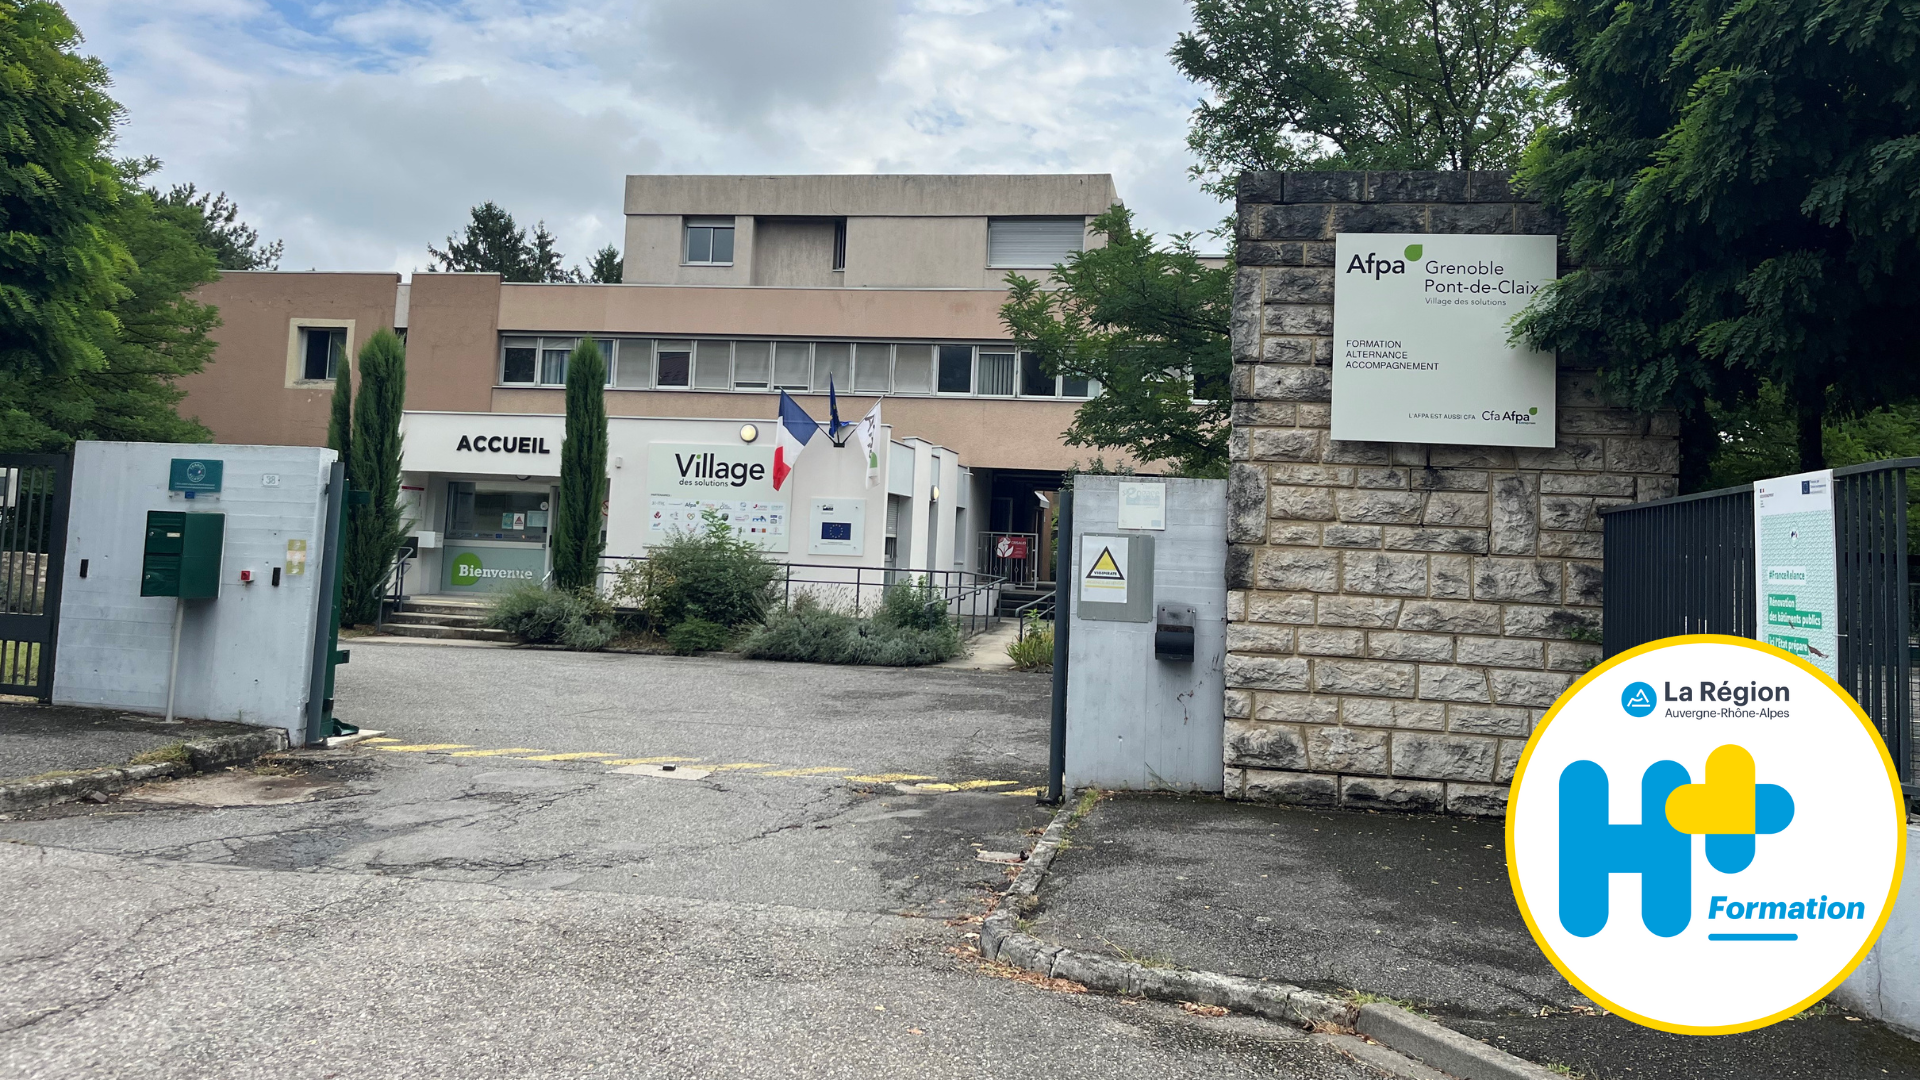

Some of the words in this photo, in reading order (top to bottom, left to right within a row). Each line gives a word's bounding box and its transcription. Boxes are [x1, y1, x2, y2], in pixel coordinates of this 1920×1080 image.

[1346, 253, 1405, 280] Afpa
[1425, 261, 1504, 275] Grenoble
[1425, 279, 1539, 294] Pont-de-Claix
[1425, 297, 1452, 307] Village
[1470, 298, 1507, 306] solutions
[1346, 340, 1402, 348] FORMATION
[1345, 351, 1408, 359] ALTERNANCE
[1345, 361, 1440, 370] ACCOMPAGNEMENT
[1481, 410, 1501, 421] Cfa
[1502, 410, 1530, 424] Afpa
[456, 435, 550, 454] ACCUEIL
[675, 453, 765, 487] Village
[694, 479, 729, 487] solutions
[458, 564, 533, 580] Bienvenue
[1802, 614, 1821, 627] publics
